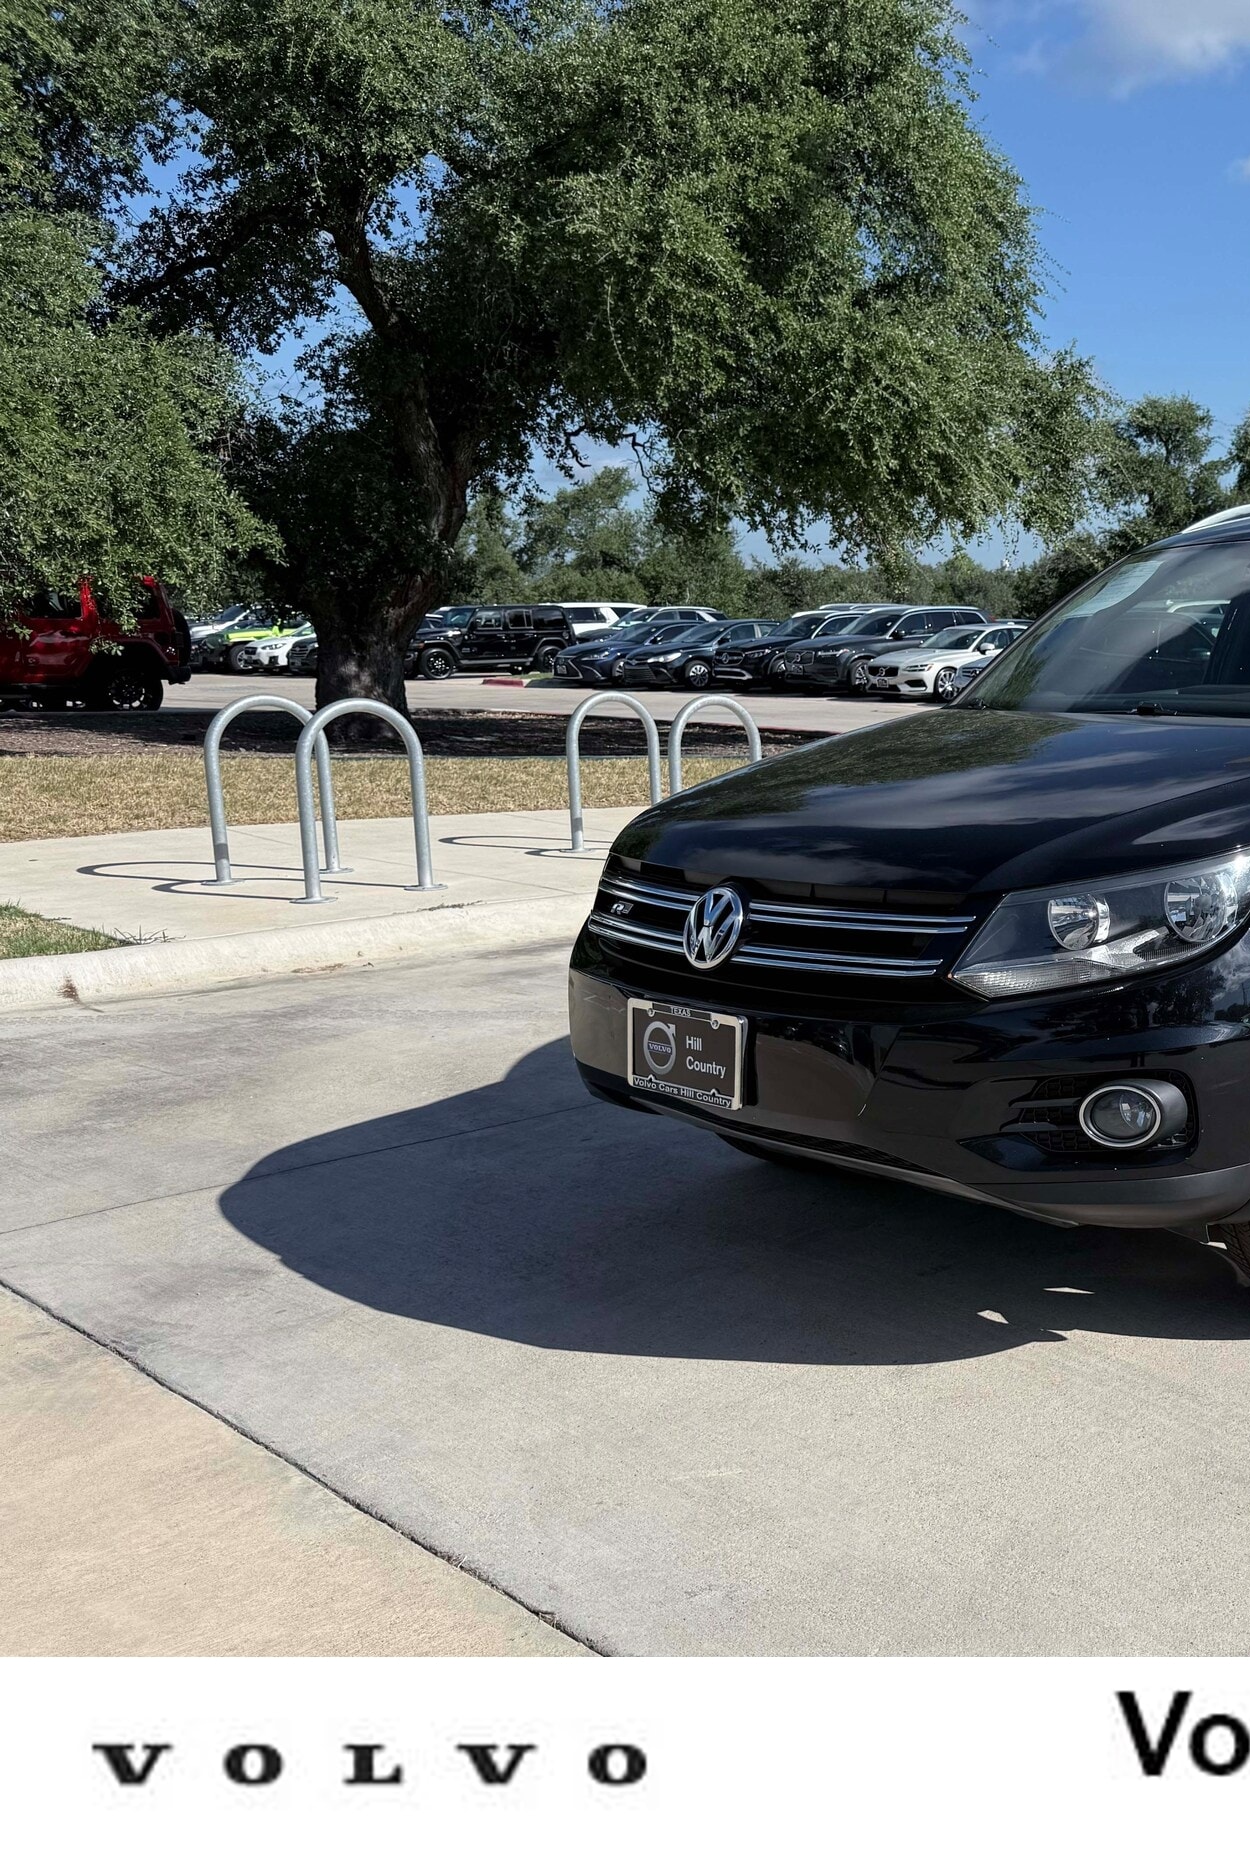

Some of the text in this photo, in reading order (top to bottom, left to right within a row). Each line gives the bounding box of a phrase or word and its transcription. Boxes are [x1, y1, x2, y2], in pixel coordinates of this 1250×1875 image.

[683, 886, 743, 969] VW
[670, 1005, 691, 1017] TEXAS
[648, 1042, 672, 1054] VOLVO
[686, 1035, 702, 1051] Hill
[686, 1056, 726, 1079] Country
[634, 1077, 731, 1108] Volvo Cars Hill Country
